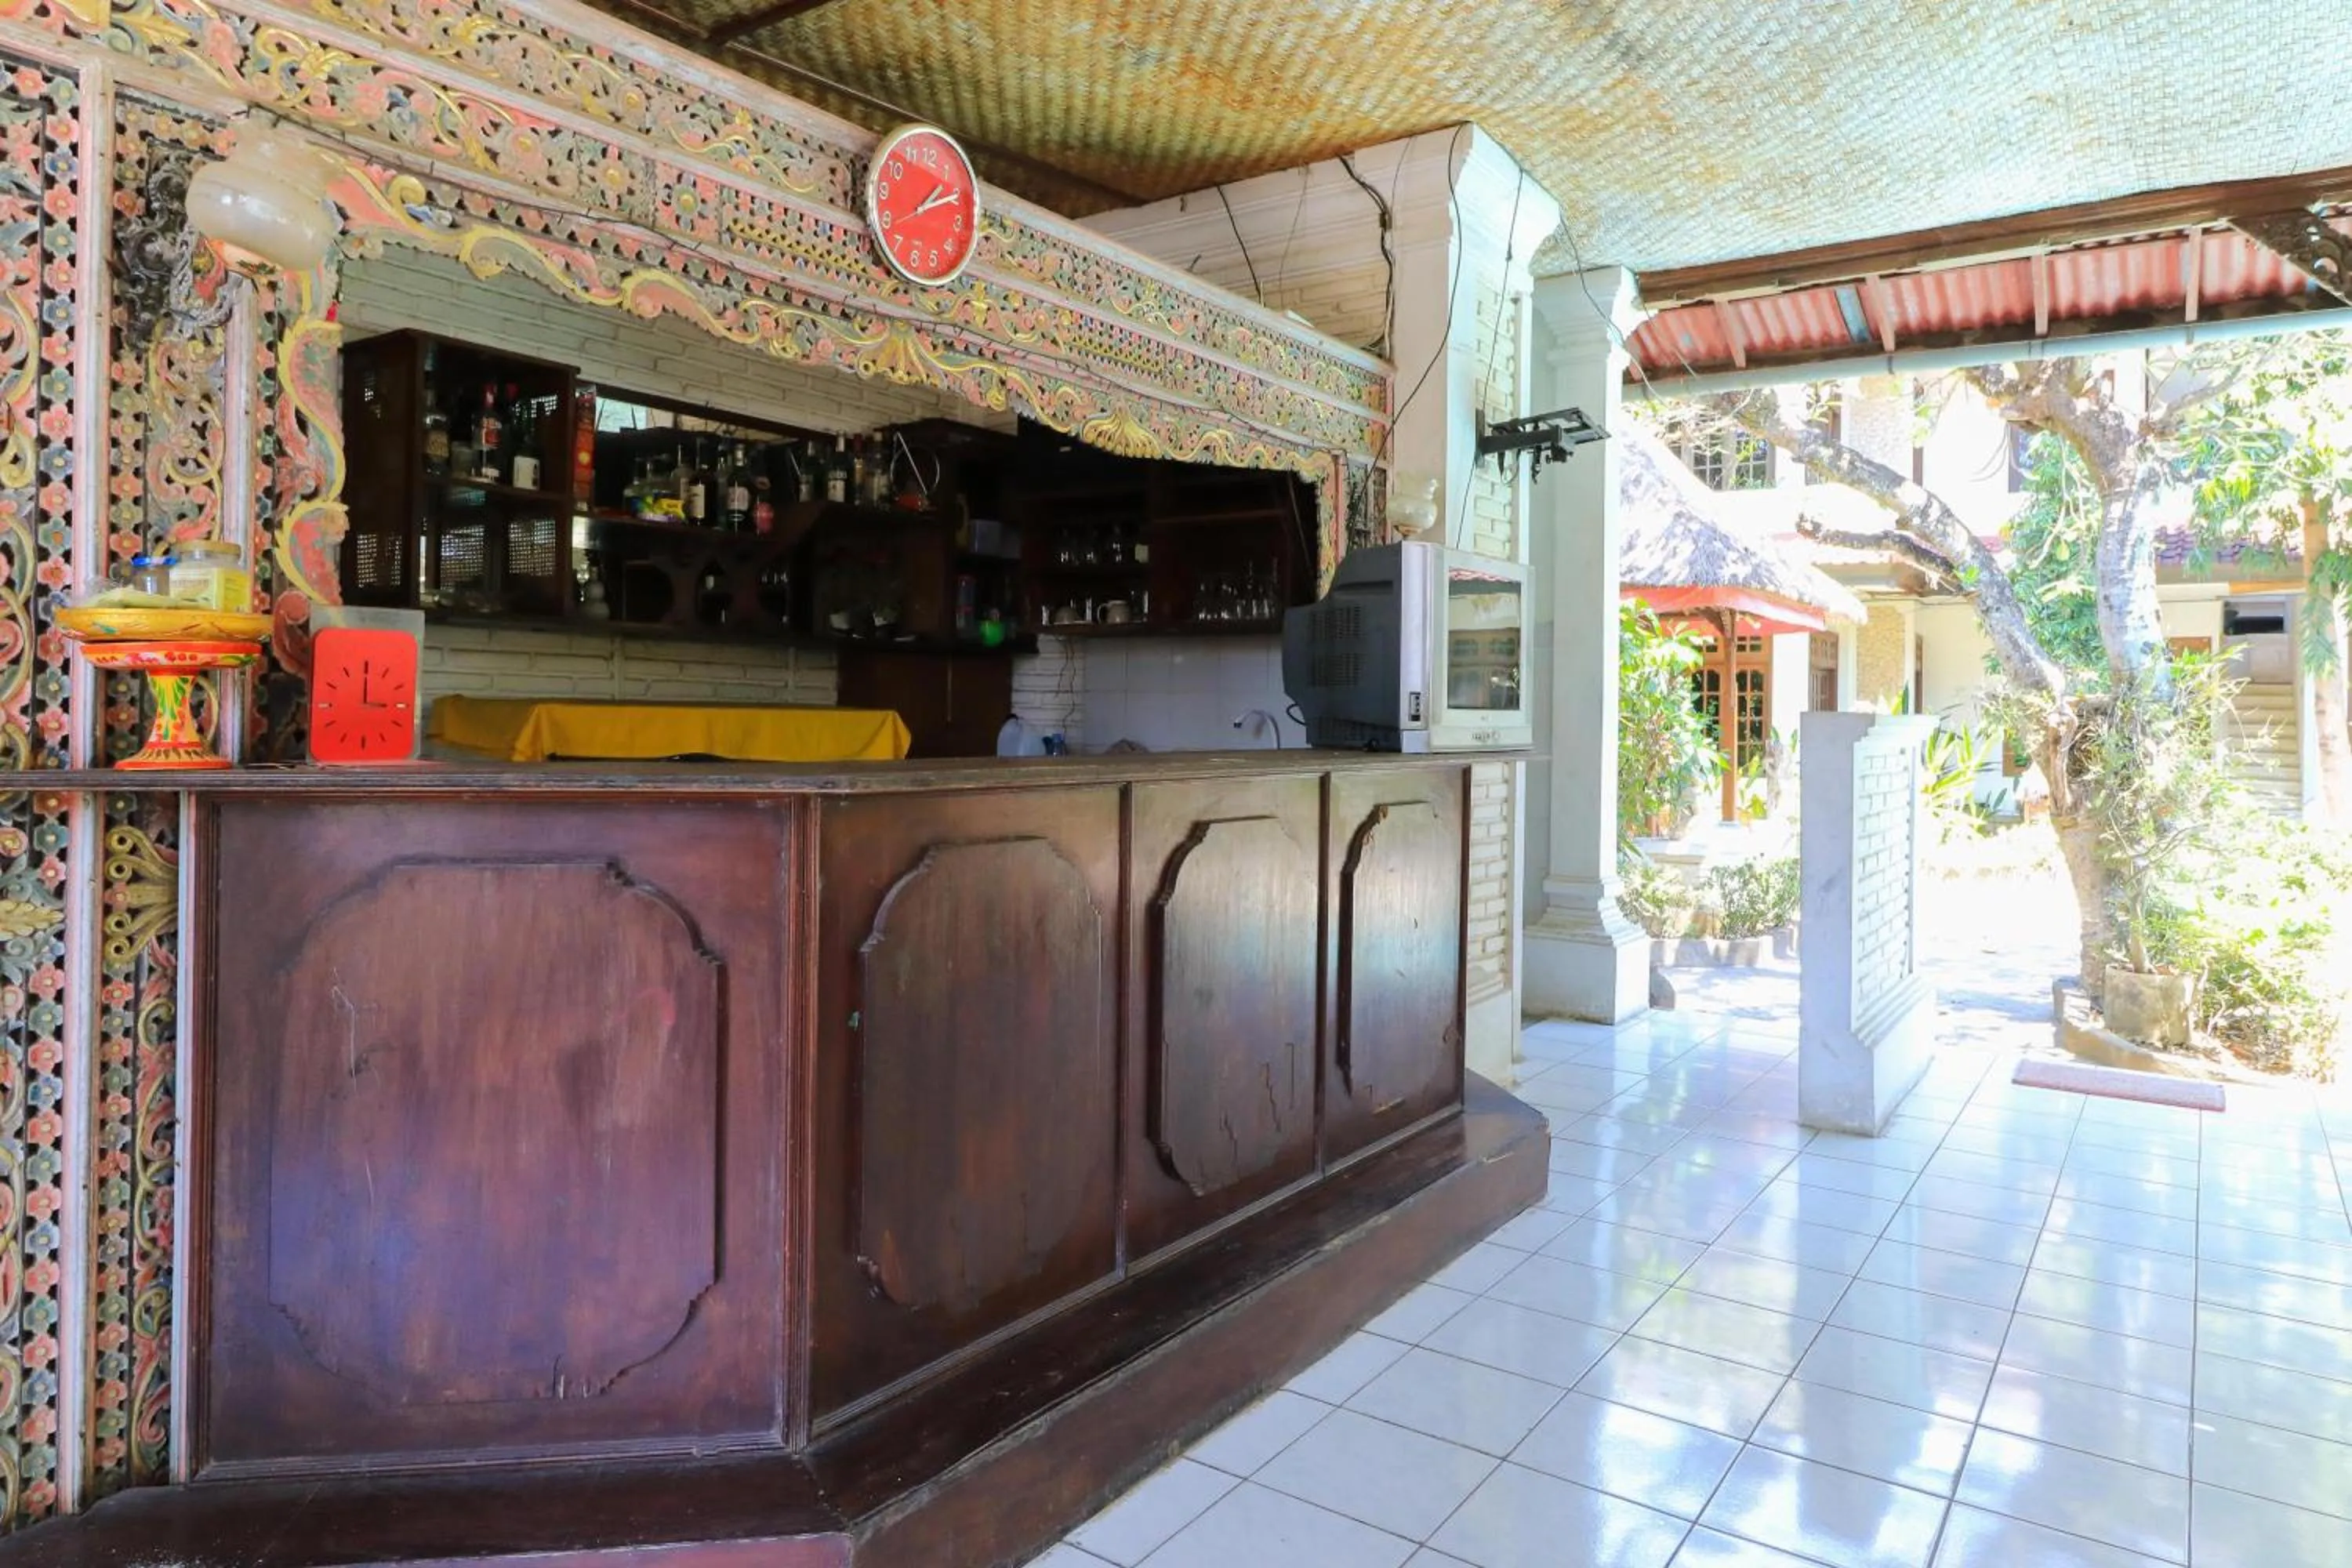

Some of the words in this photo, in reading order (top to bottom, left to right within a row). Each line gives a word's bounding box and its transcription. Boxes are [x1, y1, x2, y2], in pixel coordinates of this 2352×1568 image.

[906, 147, 918, 163] 11
[923, 147, 937, 168] 12
[888, 160, 903, 180] 10
[942, 165, 950, 180] 1
[879, 182, 889, 200] 9
[881, 211, 891, 229] 8
[953, 215, 963, 232] 3
[894, 234, 903, 252] 7
[943, 238, 953, 254] 4
[910, 250, 920, 267] 6
